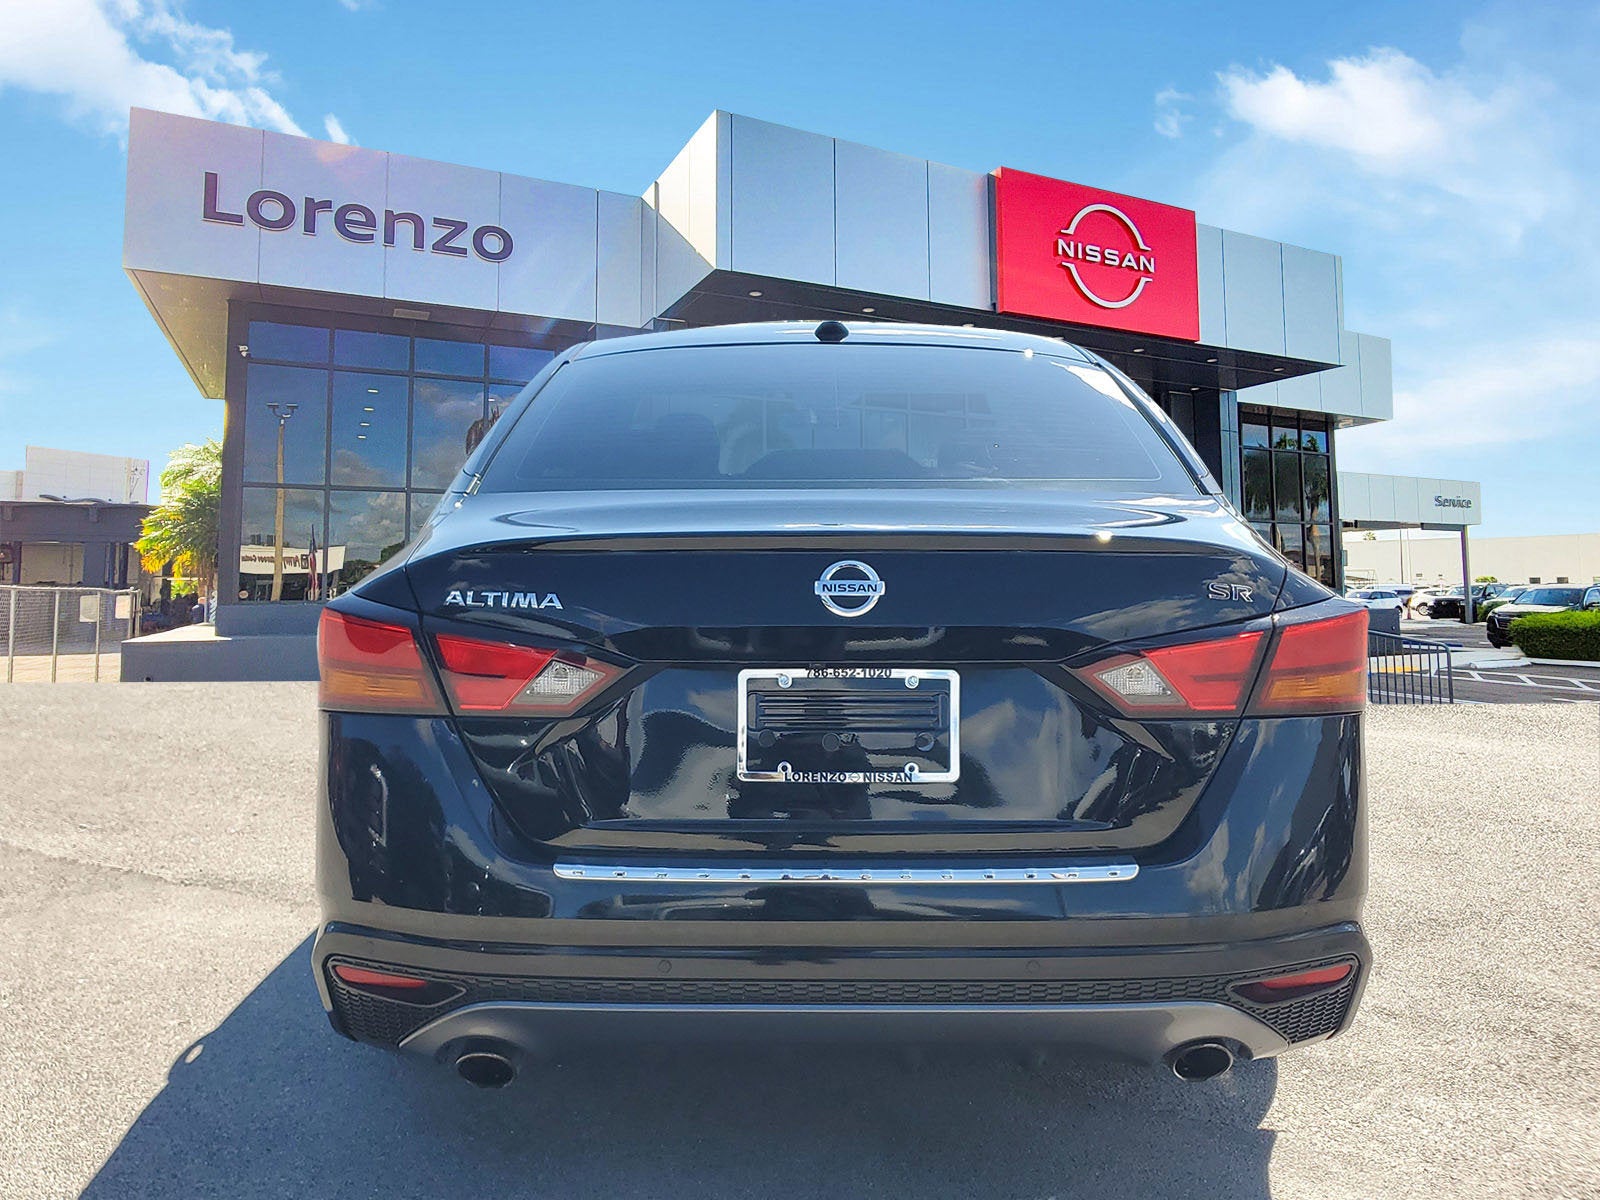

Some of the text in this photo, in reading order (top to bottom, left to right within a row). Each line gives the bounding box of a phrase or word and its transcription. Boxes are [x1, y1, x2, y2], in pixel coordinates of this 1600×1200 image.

[202, 171, 514, 263] Lorenzo
[1057, 238, 1155, 273] NISSAN
[1434, 495, 1472, 508] Service
[822, 583, 878, 593] NISSAN
[1208, 582, 1253, 602] SR
[444, 590, 563, 610] ALTIMA
[806, 667, 892, 679] 786-652-1020
[784, 771, 847, 783] LORENZO
[863, 771, 913, 783] NISSAN
